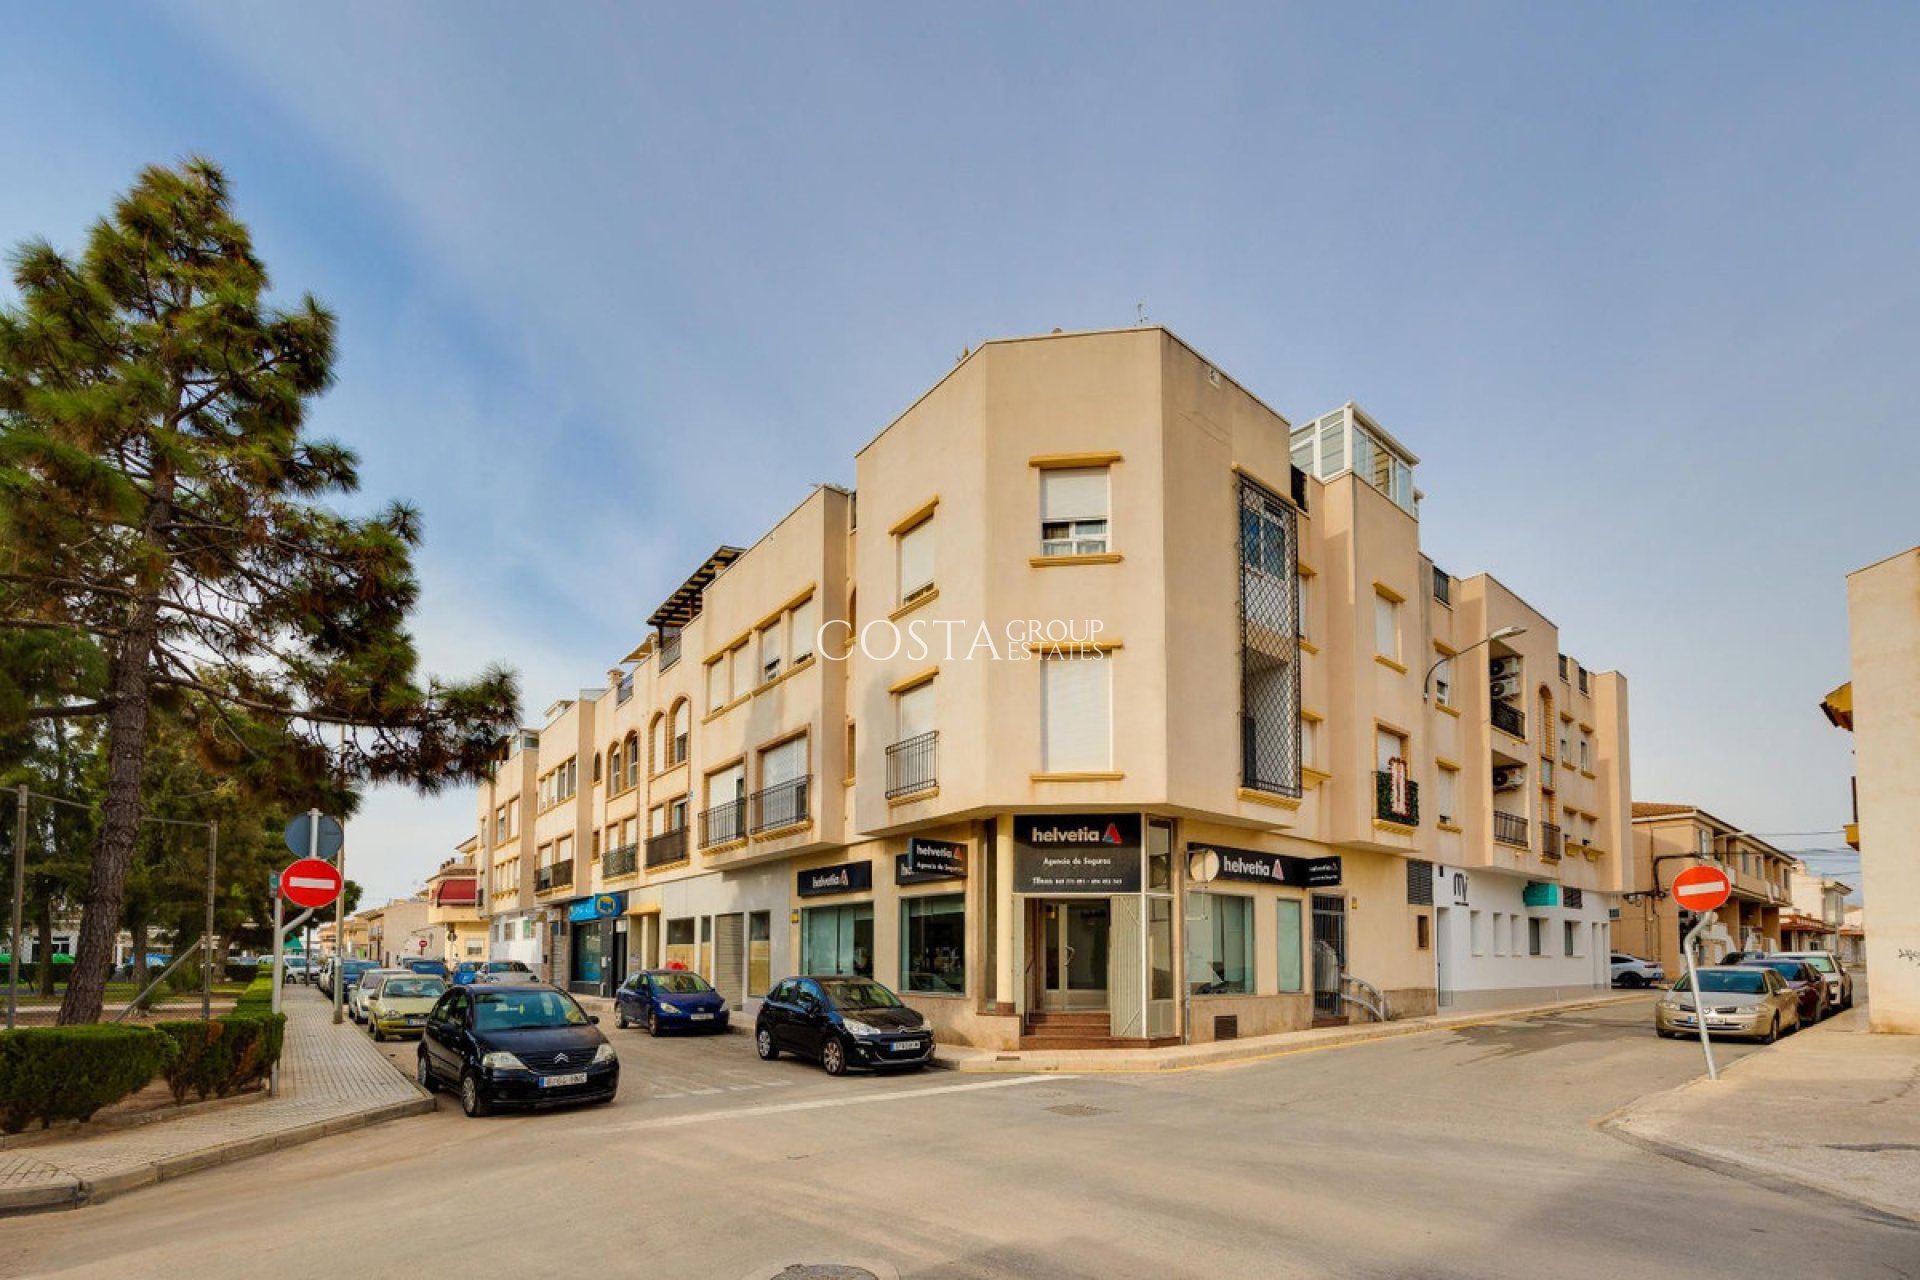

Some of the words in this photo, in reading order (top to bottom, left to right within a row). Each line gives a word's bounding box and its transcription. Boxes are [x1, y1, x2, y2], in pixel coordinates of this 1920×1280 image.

[1032, 827, 1100, 842] helvetia
[917, 844, 953, 859] helvetia
[1223, 855, 1270, 876] helvetia
[812, 873, 840, 889] helvetia
